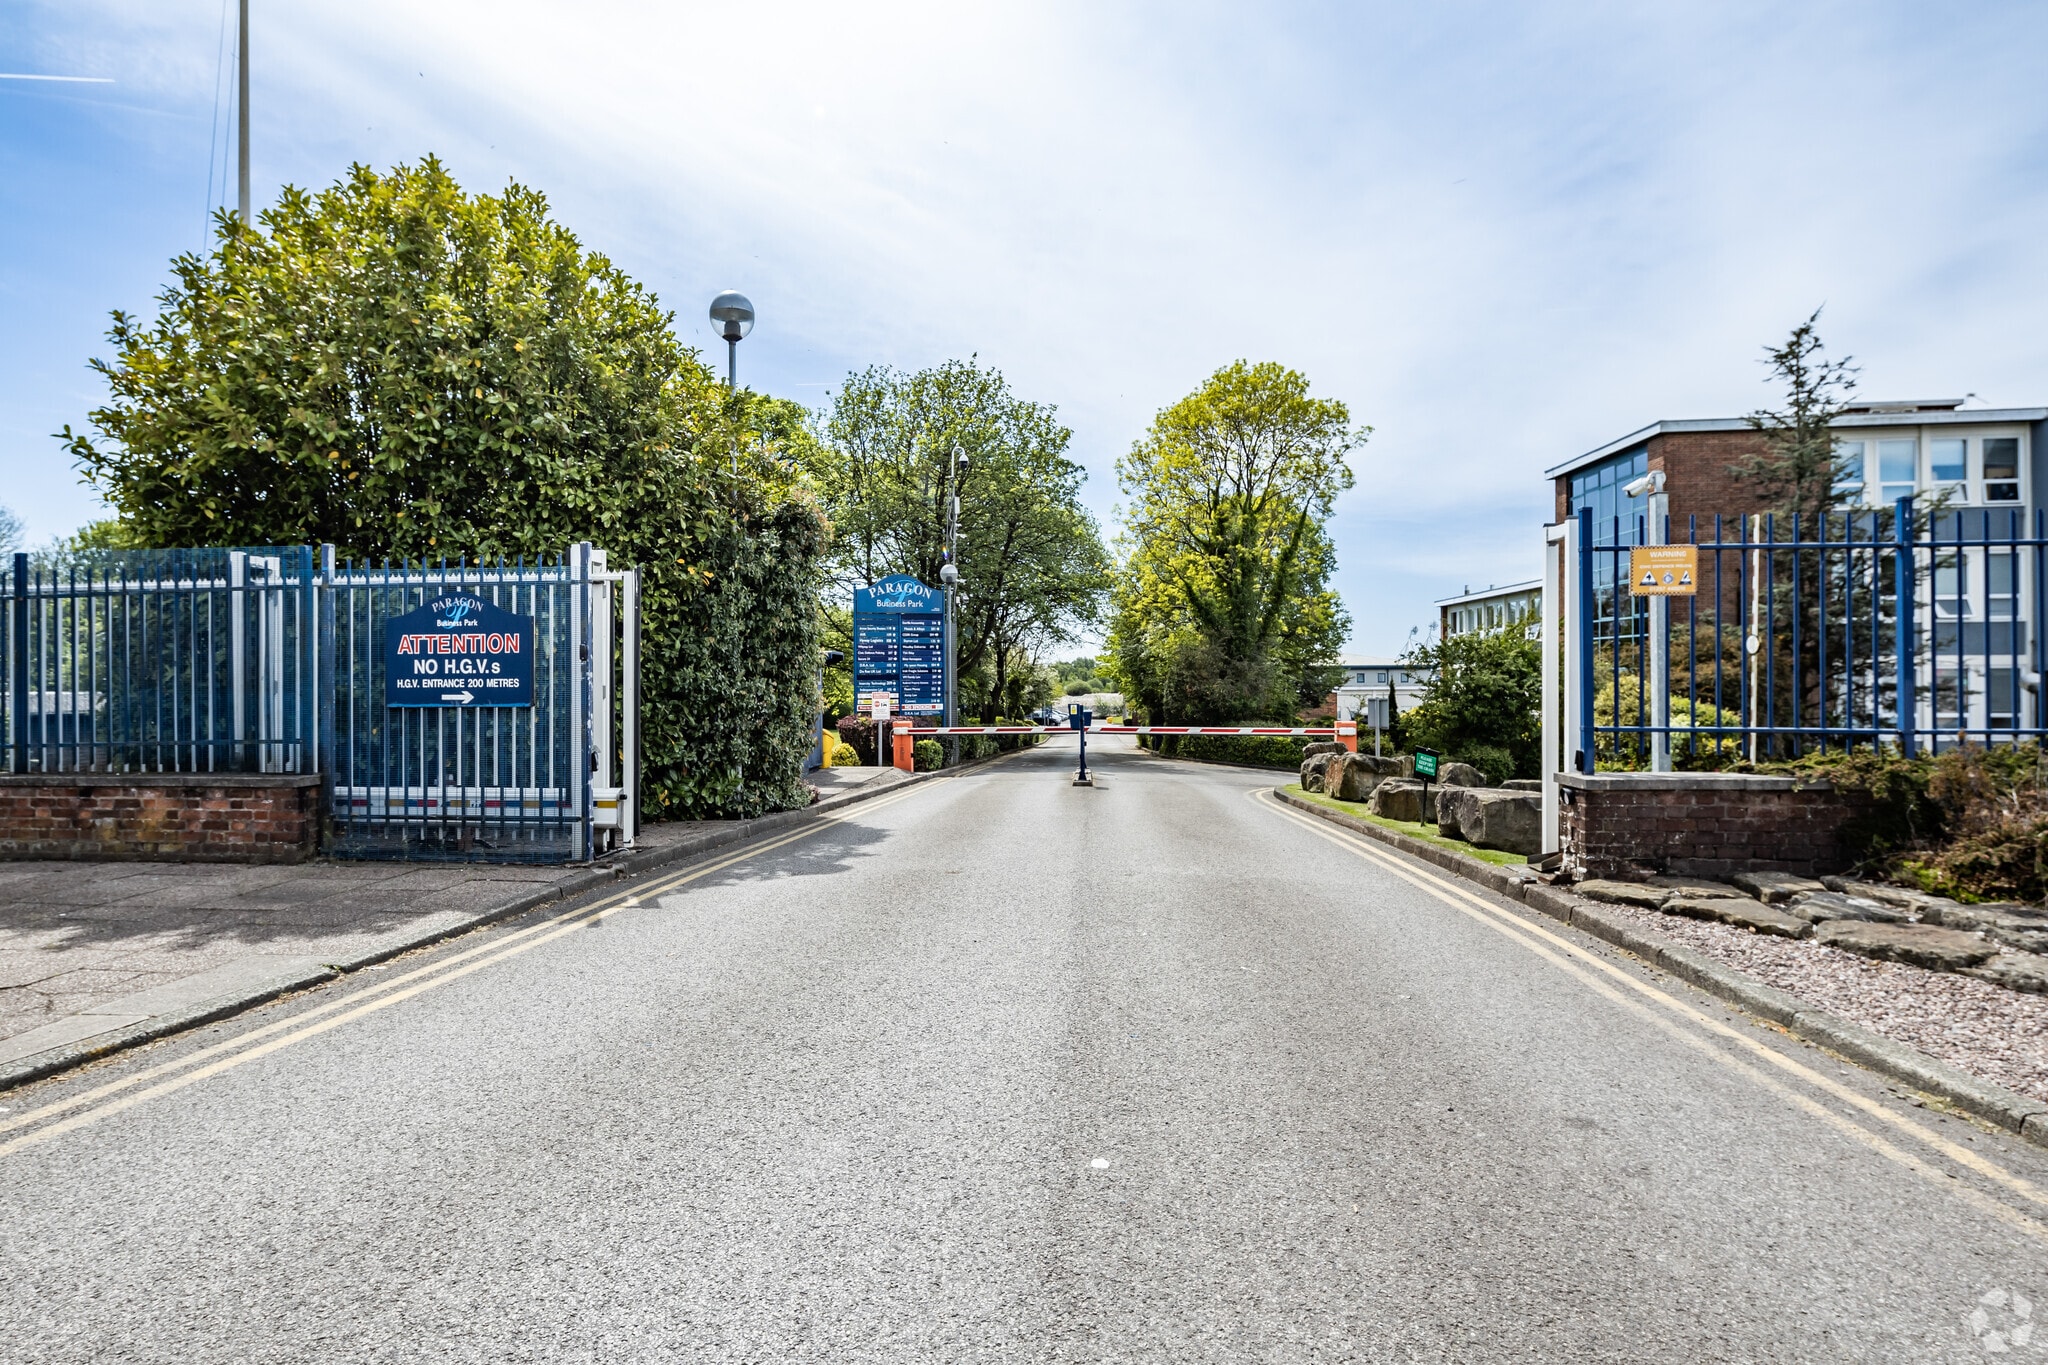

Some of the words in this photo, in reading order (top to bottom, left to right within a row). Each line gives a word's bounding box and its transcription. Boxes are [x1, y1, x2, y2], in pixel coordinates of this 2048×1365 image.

[1650, 550, 1687, 558] WARNING
[868, 582, 932, 600] PARAGON
[431, 597, 484, 613] PARAGON
[876, 599, 906, 608] Business
[907, 599, 924, 608] Park
[436, 619, 463, 627] Business
[463, 618, 478, 627] Park
[397, 633, 520, 655] ATTENTION
[413, 659, 438, 674] NO
[397, 678, 420, 688] H.G.V.
[422, 678, 465, 688] ENTRANCE
[467, 678, 484, 688] 200
[486, 678, 520, 688] METRES
